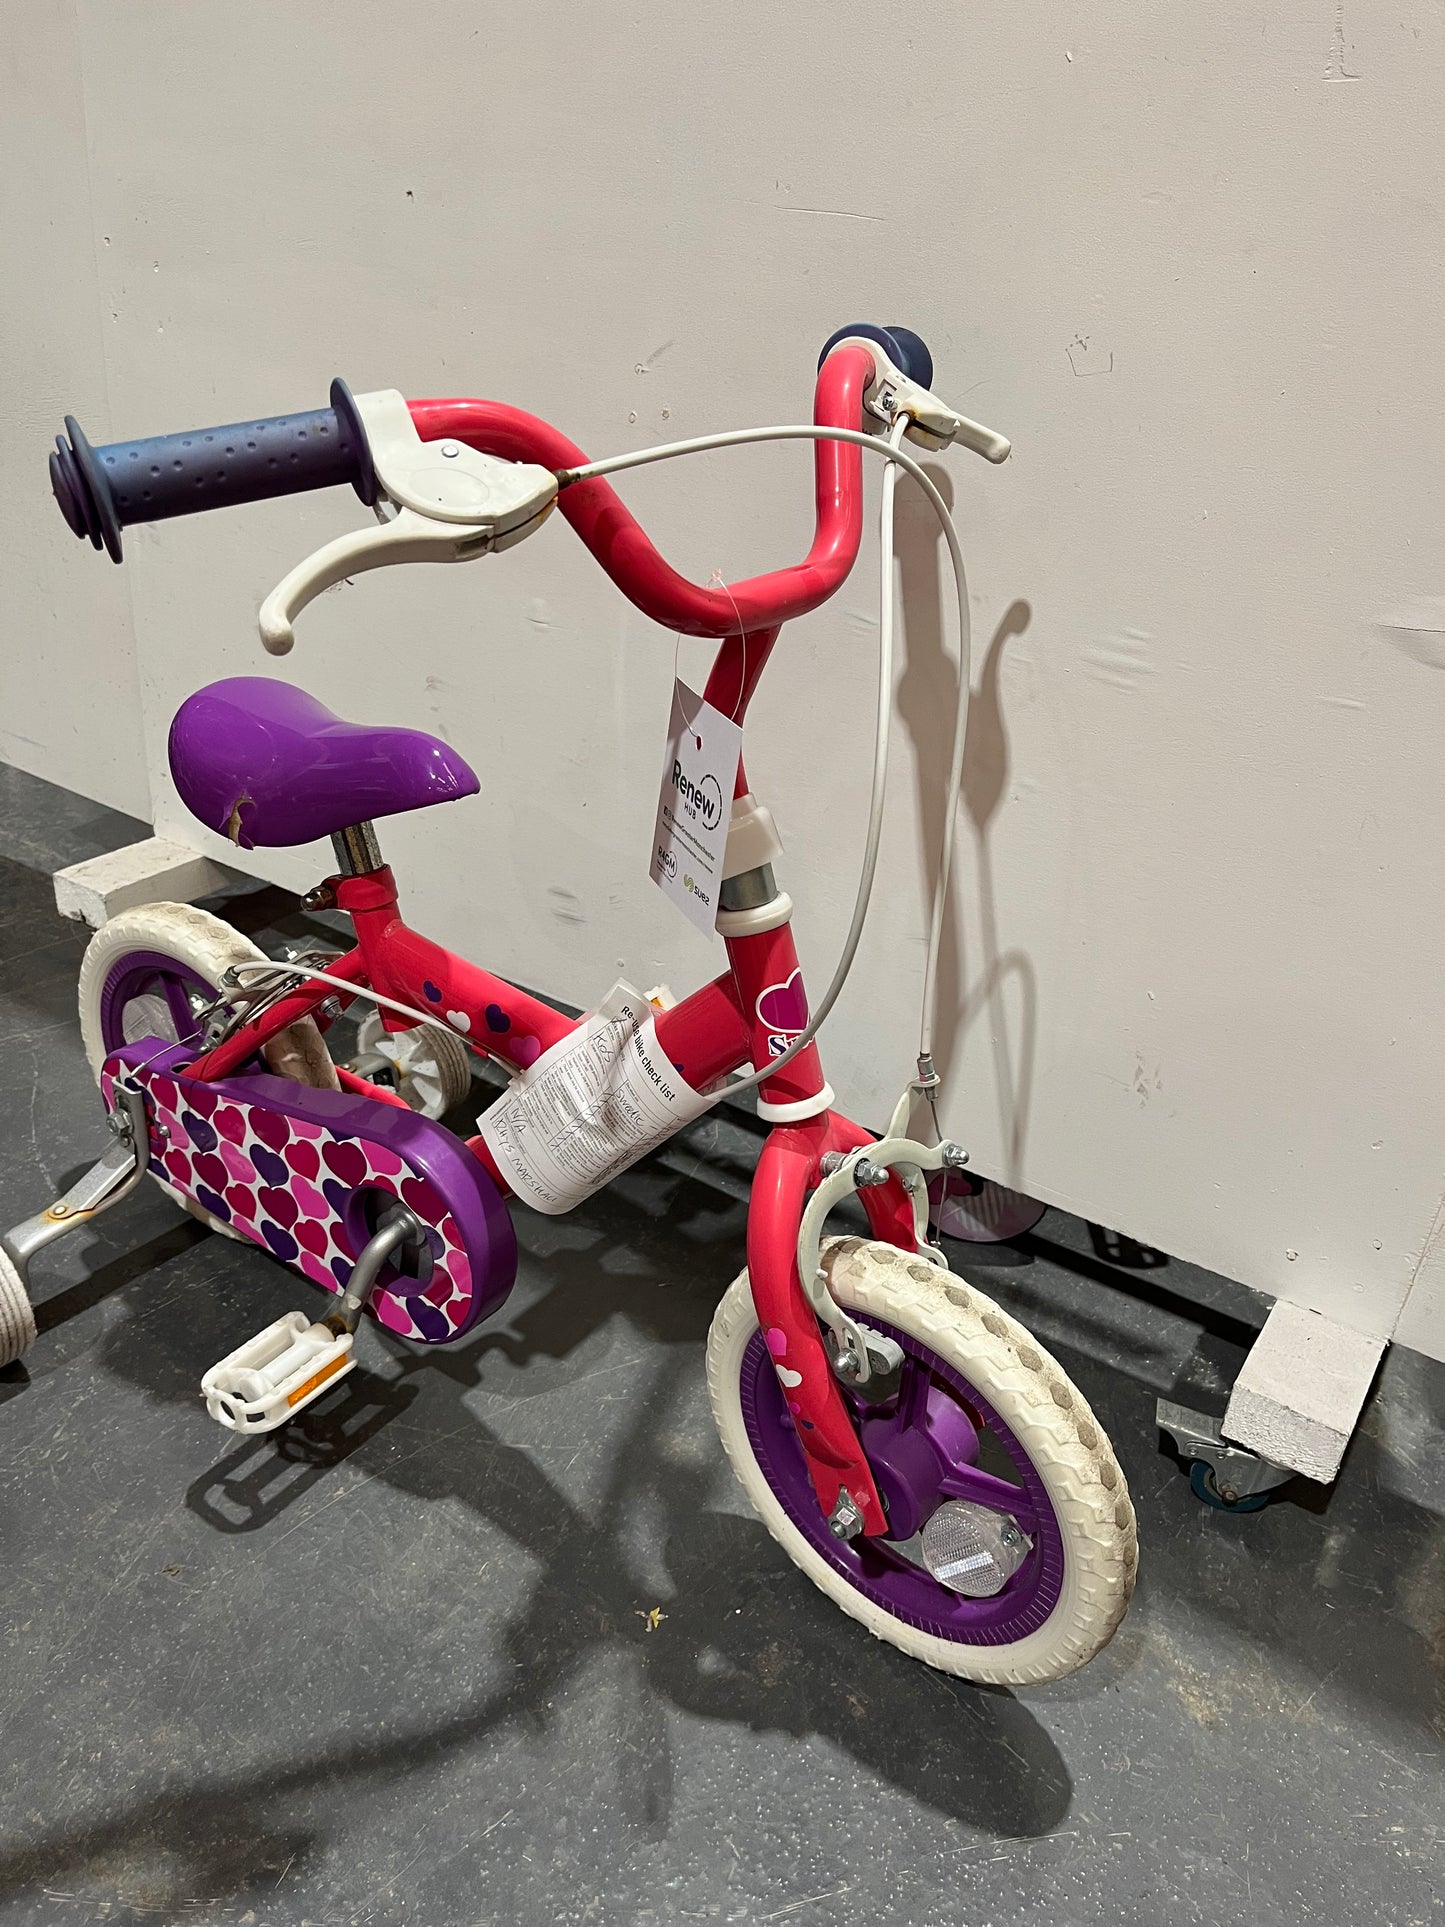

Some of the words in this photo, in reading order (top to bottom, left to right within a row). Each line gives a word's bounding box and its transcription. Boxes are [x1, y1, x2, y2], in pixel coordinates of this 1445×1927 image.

[672, 759, 714, 819] Renew
[684, 802, 696, 820] HUB
[621, 1006, 640, 1037] Re-use
[634, 1034, 645, 1057] bike
[641, 1056, 662, 1086] check
[660, 1083, 676, 1101] list
[510, 1107, 528, 1136] N/A
